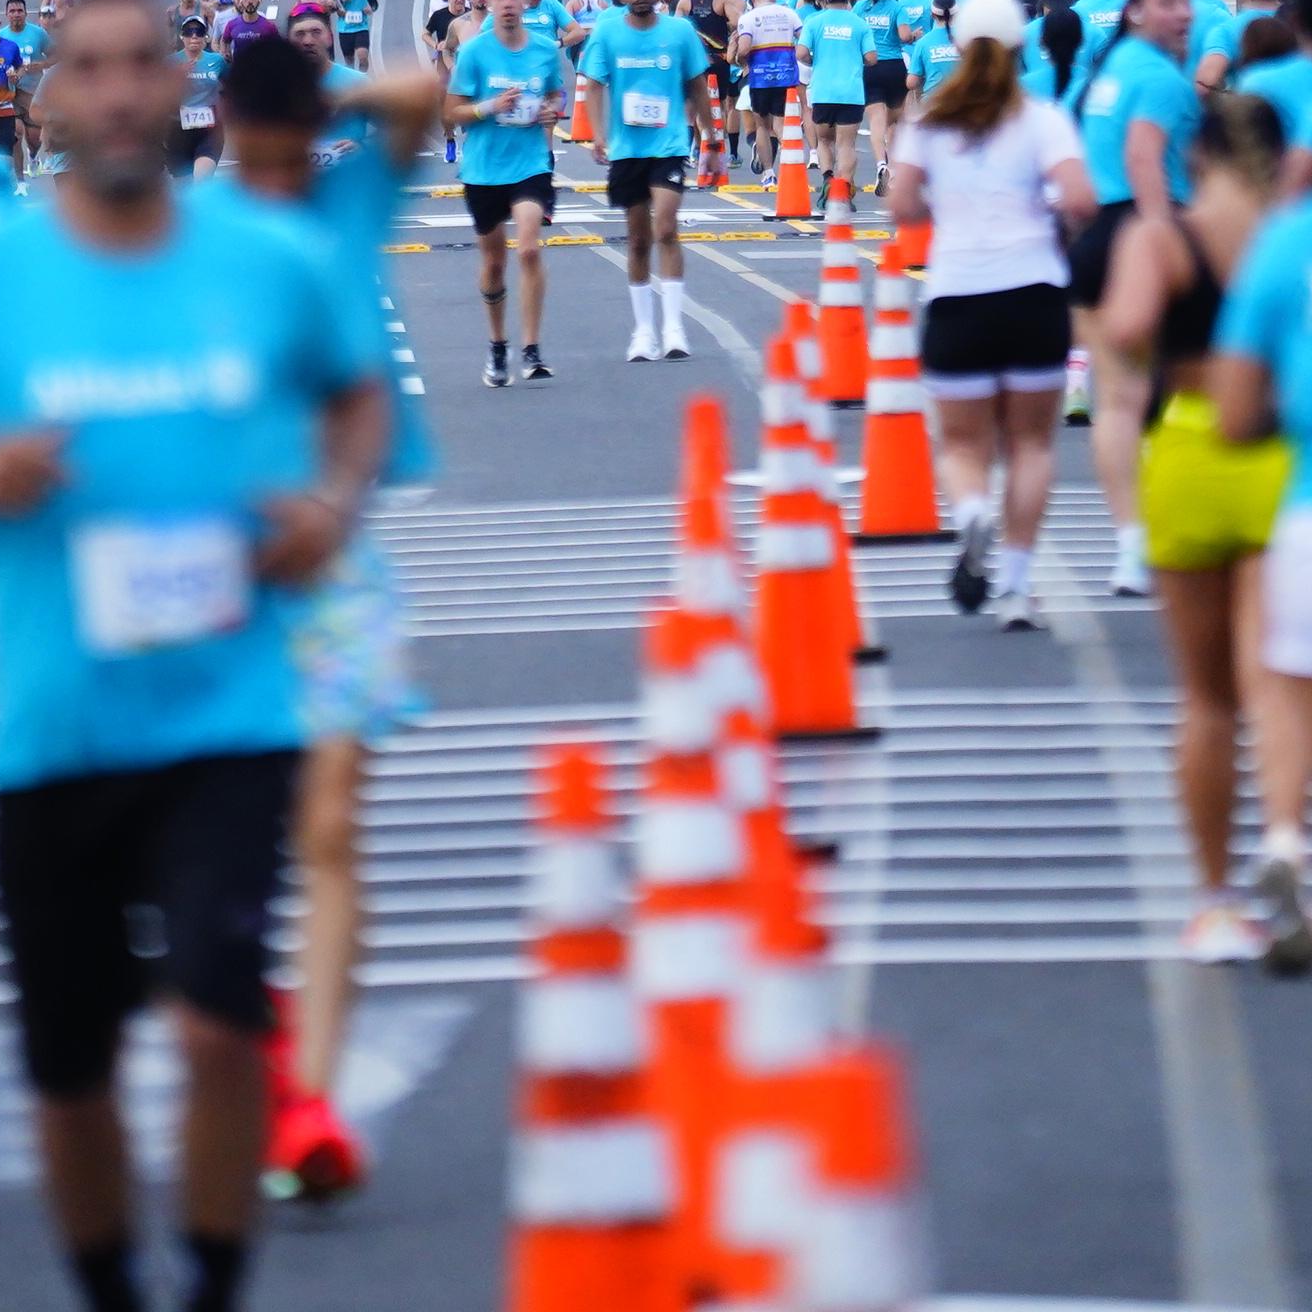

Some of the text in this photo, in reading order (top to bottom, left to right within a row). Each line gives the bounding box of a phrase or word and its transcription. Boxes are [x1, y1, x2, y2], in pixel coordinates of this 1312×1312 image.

[1089, 13, 1110, 24] 15K
[930, 47, 952, 58] 15K
[185, 112, 212, 124] 1741
